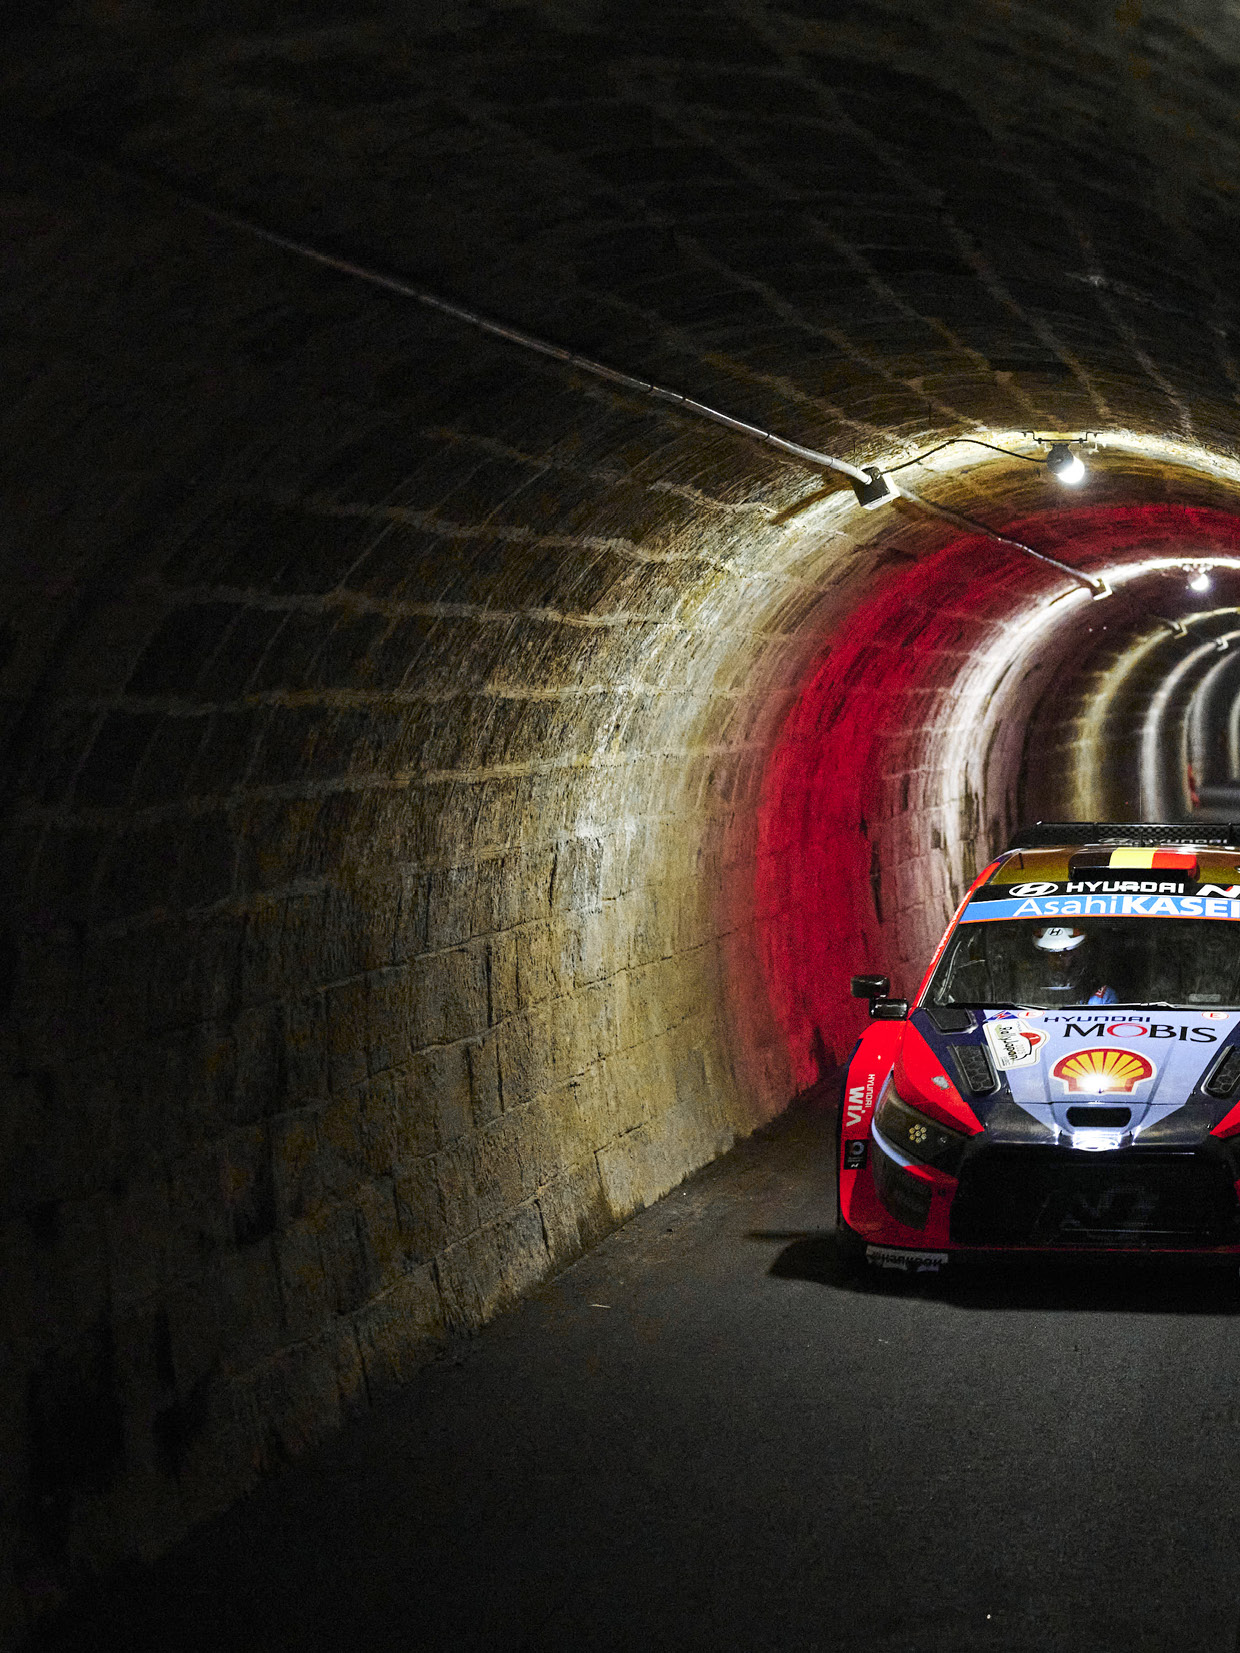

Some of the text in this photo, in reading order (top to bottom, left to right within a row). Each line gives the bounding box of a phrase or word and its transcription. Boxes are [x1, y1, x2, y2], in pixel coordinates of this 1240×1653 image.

[1066, 880, 1185, 894] HYUNDAI
[1063, 1023, 1218, 1043] MOBIS
[865, 1073, 875, 1108] HYUNDAI
